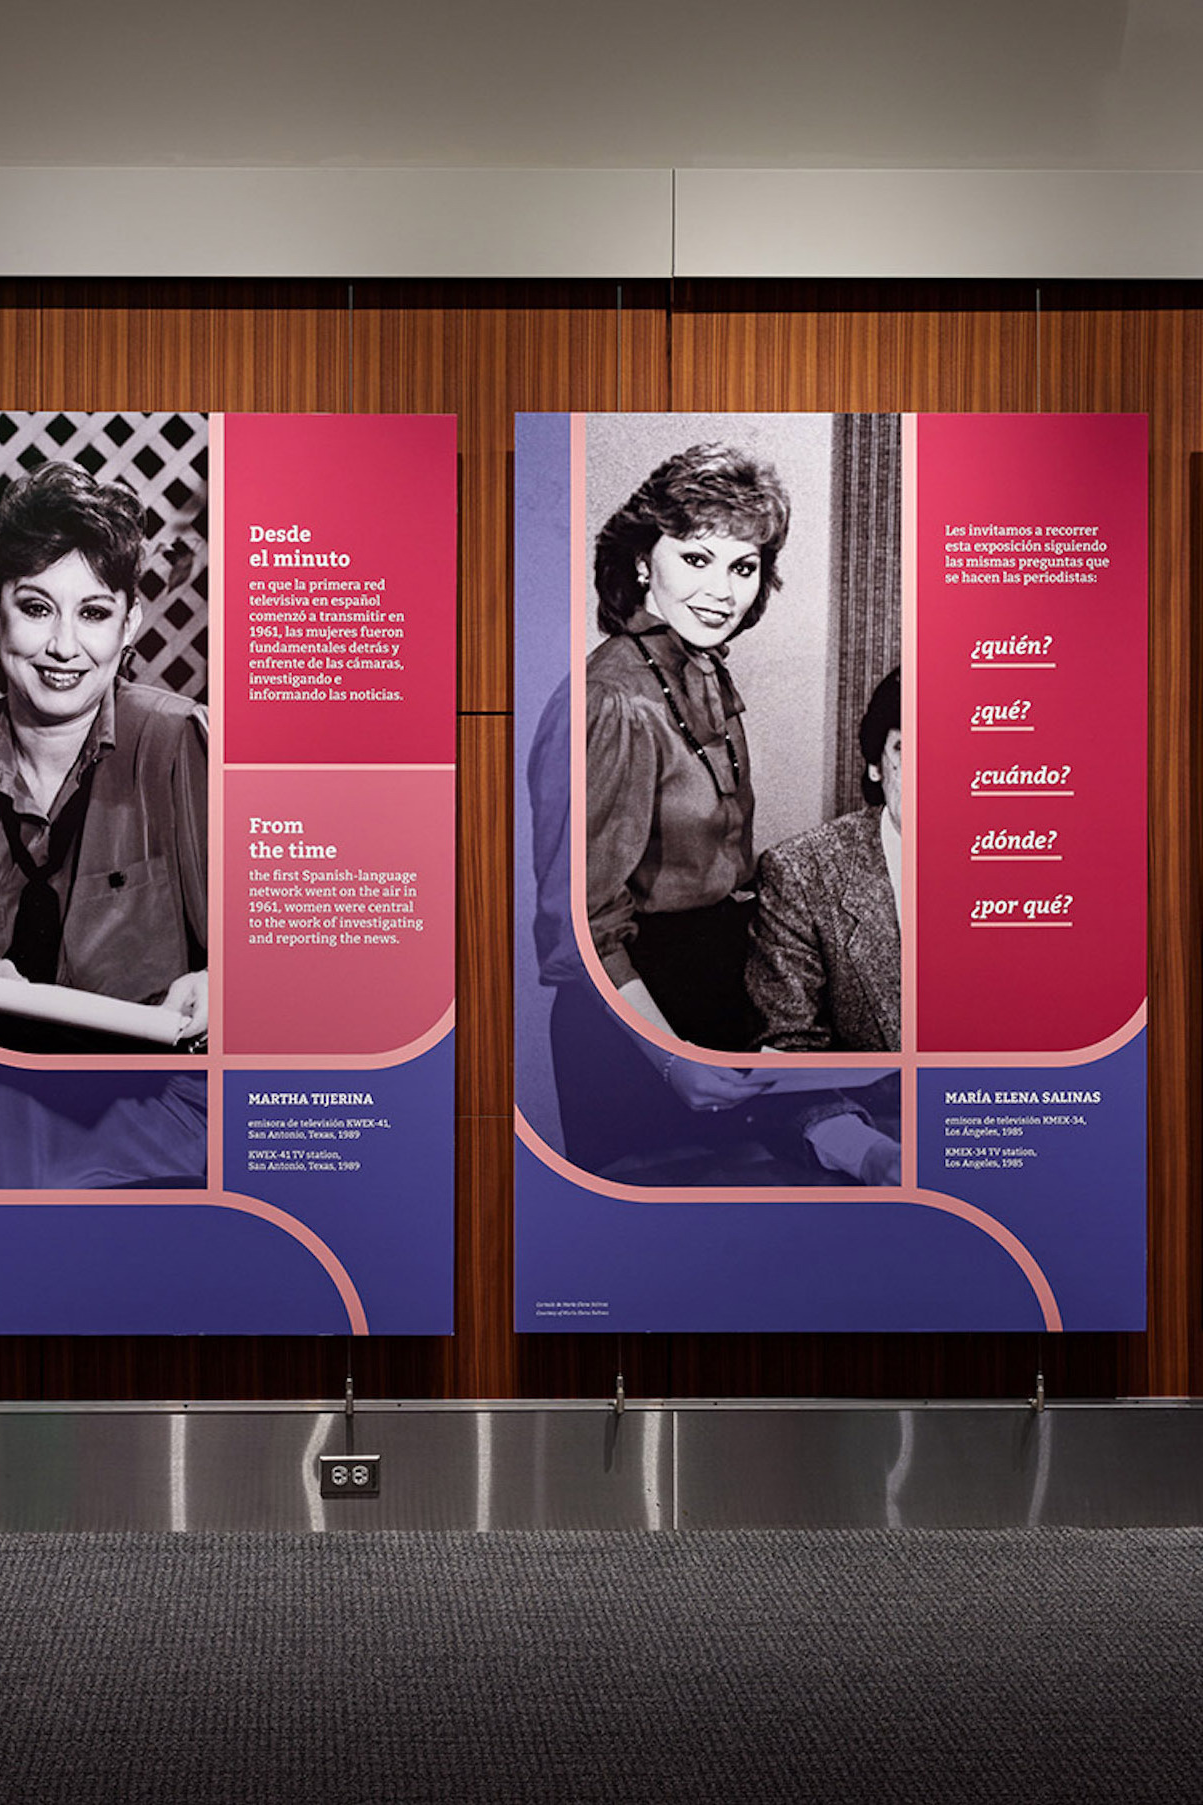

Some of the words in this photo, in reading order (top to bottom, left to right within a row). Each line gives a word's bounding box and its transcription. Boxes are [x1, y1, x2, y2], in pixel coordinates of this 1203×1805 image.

[250, 525, 311, 542] Desde
[945, 525, 966, 536] Les
[968, 524, 1033, 536] invitamos
[1035, 527, 1043, 536] a
[1046, 526, 1099, 536] recorrer
[945, 541, 972, 552] esta
[974, 539, 1042, 555] exposición
[1044, 539, 1107, 555] siguiendo
[249, 549, 269, 567] el
[273, 549, 350, 567] minuto
[945, 555, 964, 568] las
[966, 555, 1016, 568] mismas
[1018, 557, 1084, 571] preguntas
[1086, 558, 1110, 570] que
[249, 581, 265, 590] en
[268, 581, 292, 593] que
[294, 578, 306, 590] la
[309, 578, 361, 593] primera
[364, 578, 385, 591] red
[945, 573, 959, 584] se
[961, 571, 1000, 584] hacen
[1003, 571, 1021, 584] las
[1023, 571, 1097, 586] periodistas:
[249, 594, 310, 606] televisiva
[312, 597, 329, 606] en
[331, 594, 380, 609] español
[249, 626, 282, 641] 1961,
[285, 625, 303, 638] las
[306, 626, 358, 641] mujeres
[360, 625, 404, 638] fueron
[249, 641, 346, 654] fundamentales
[348, 641, 389, 654] detrás
[391, 644, 400, 656] y
[971, 635, 1052, 660] ¿quién?
[249, 657, 305, 669] enfrente
[307, 657, 323, 669] de
[326, 657, 344, 669] las
[346, 657, 404, 670] cámaras,
[249, 672, 332, 688] investigando
[334, 675, 342, 685] e
[249, 688, 327, 701] informando
[329, 688, 347, 701] las
[349, 688, 403, 701] noticias.
[971, 699, 1031, 725] ¿qué?
[971, 765, 1071, 789] ¿cuándo?
[249, 817, 304, 834] From
[971, 829, 1057, 854] ¿dónde?
[249, 841, 284, 859] the
[288, 840, 337, 859] time
[249, 869, 270, 881] the
[273, 869, 299, 881] first
[302, 869, 417, 884] Spanish-language
[249, 885, 303, 897] network
[305, 886, 337, 897] went
[339, 887, 356, 897] on
[359, 885, 380, 897] the
[382, 885, 401, 897] air
[404, 885, 417, 897] in
[249, 901, 282, 914] 1961,
[284, 903, 332, 913] women
[334, 903, 366, 913] were
[368, 901, 414, 913] central
[971, 900, 1019, 919] ¿por
[1023, 894, 1073, 919] qué?
[249, 918, 262, 928] to
[265, 916, 286, 928] the
[288, 916, 321, 928] work
[323, 916, 338, 928] of
[339, 916, 423, 931] investigating
[249, 932, 273, 944] and
[276, 932, 337, 947] reporting
[340, 932, 361, 944] the
[364, 935, 400, 944] news.
[249, 1093, 309, 1105] MARTHA
[311, 1093, 374, 1107] TIJERINA
[945, 1089, 992, 1104] MARÍA
[995, 1092, 1039, 1104] ELENA
[1042, 1091, 1101, 1104] SALINAS
[248, 1130, 266, 1139] San
[267, 1130, 307, 1139] Antonio,
[308, 1130, 337, 1139] Texas,
[338, 1130, 361, 1139] 1989
[945, 1127, 960, 1136] Los
[962, 1126, 1001, 1138] Ángeles,
[1002, 1127, 1023, 1136] 1985
